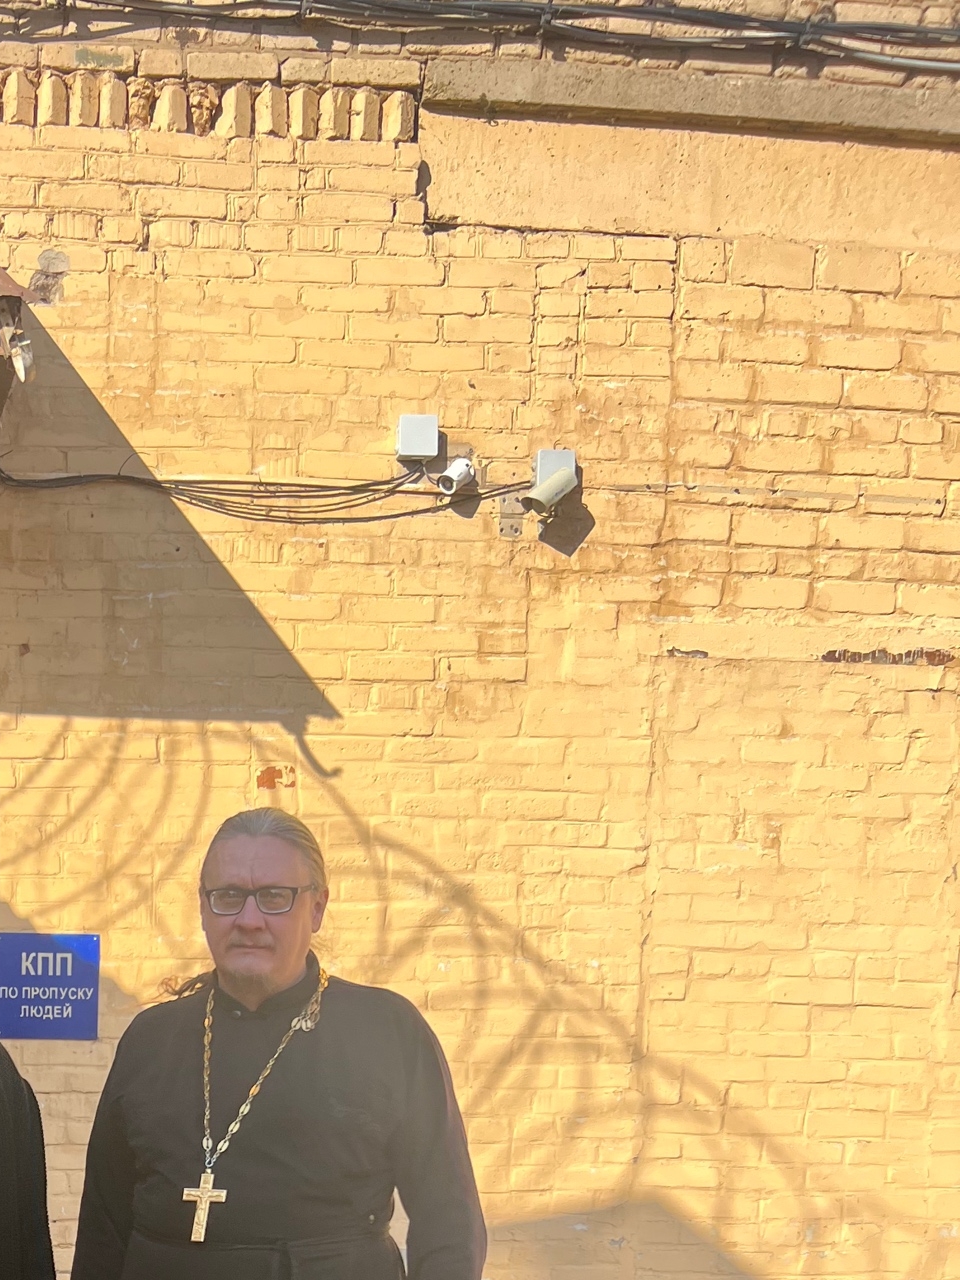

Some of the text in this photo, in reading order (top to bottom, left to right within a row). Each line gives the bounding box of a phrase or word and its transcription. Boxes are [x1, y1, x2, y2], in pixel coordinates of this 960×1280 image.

[21, 951, 73, 976] КПП
[0, 986, 94, 1000] ПО ПРОПУСКУ
[19, 1003, 72, 1020] ЛЮДЕЙ
